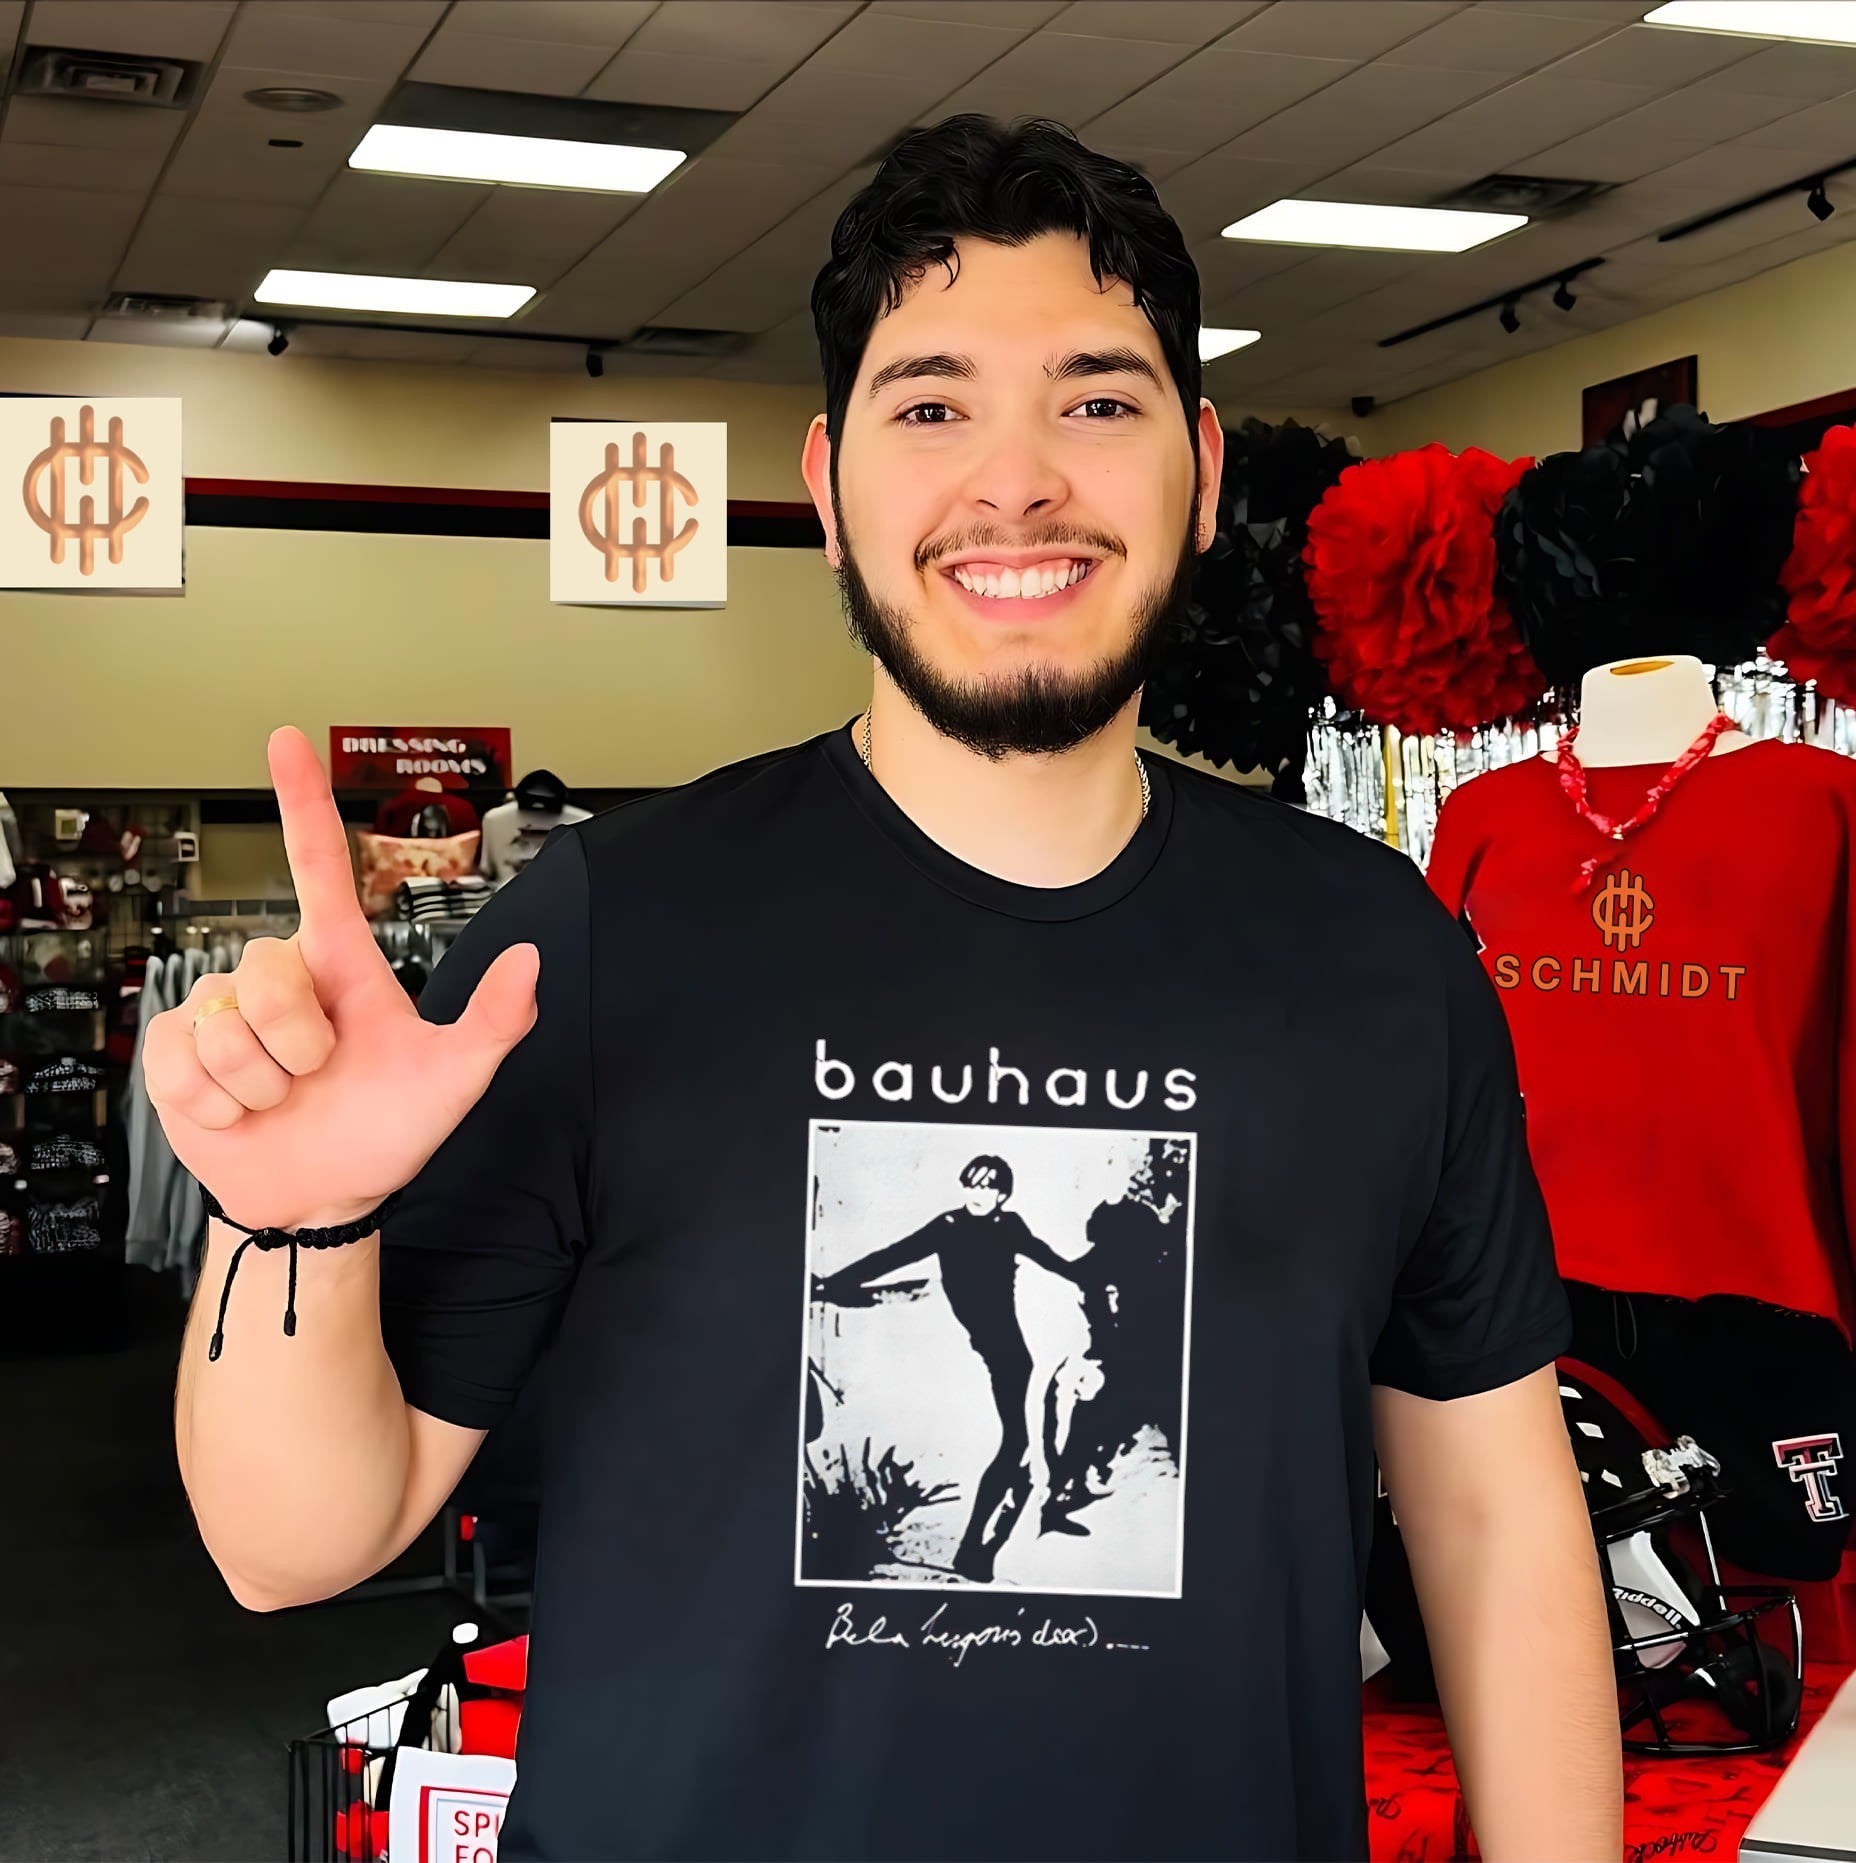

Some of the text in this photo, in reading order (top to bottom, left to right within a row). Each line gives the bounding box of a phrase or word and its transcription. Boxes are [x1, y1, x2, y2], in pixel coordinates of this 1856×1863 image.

[396, 758, 487, 775] ROOMS
[1494, 953, 1747, 1000] SCHMIDT
[815, 1039, 1197, 1111] bauhaus
